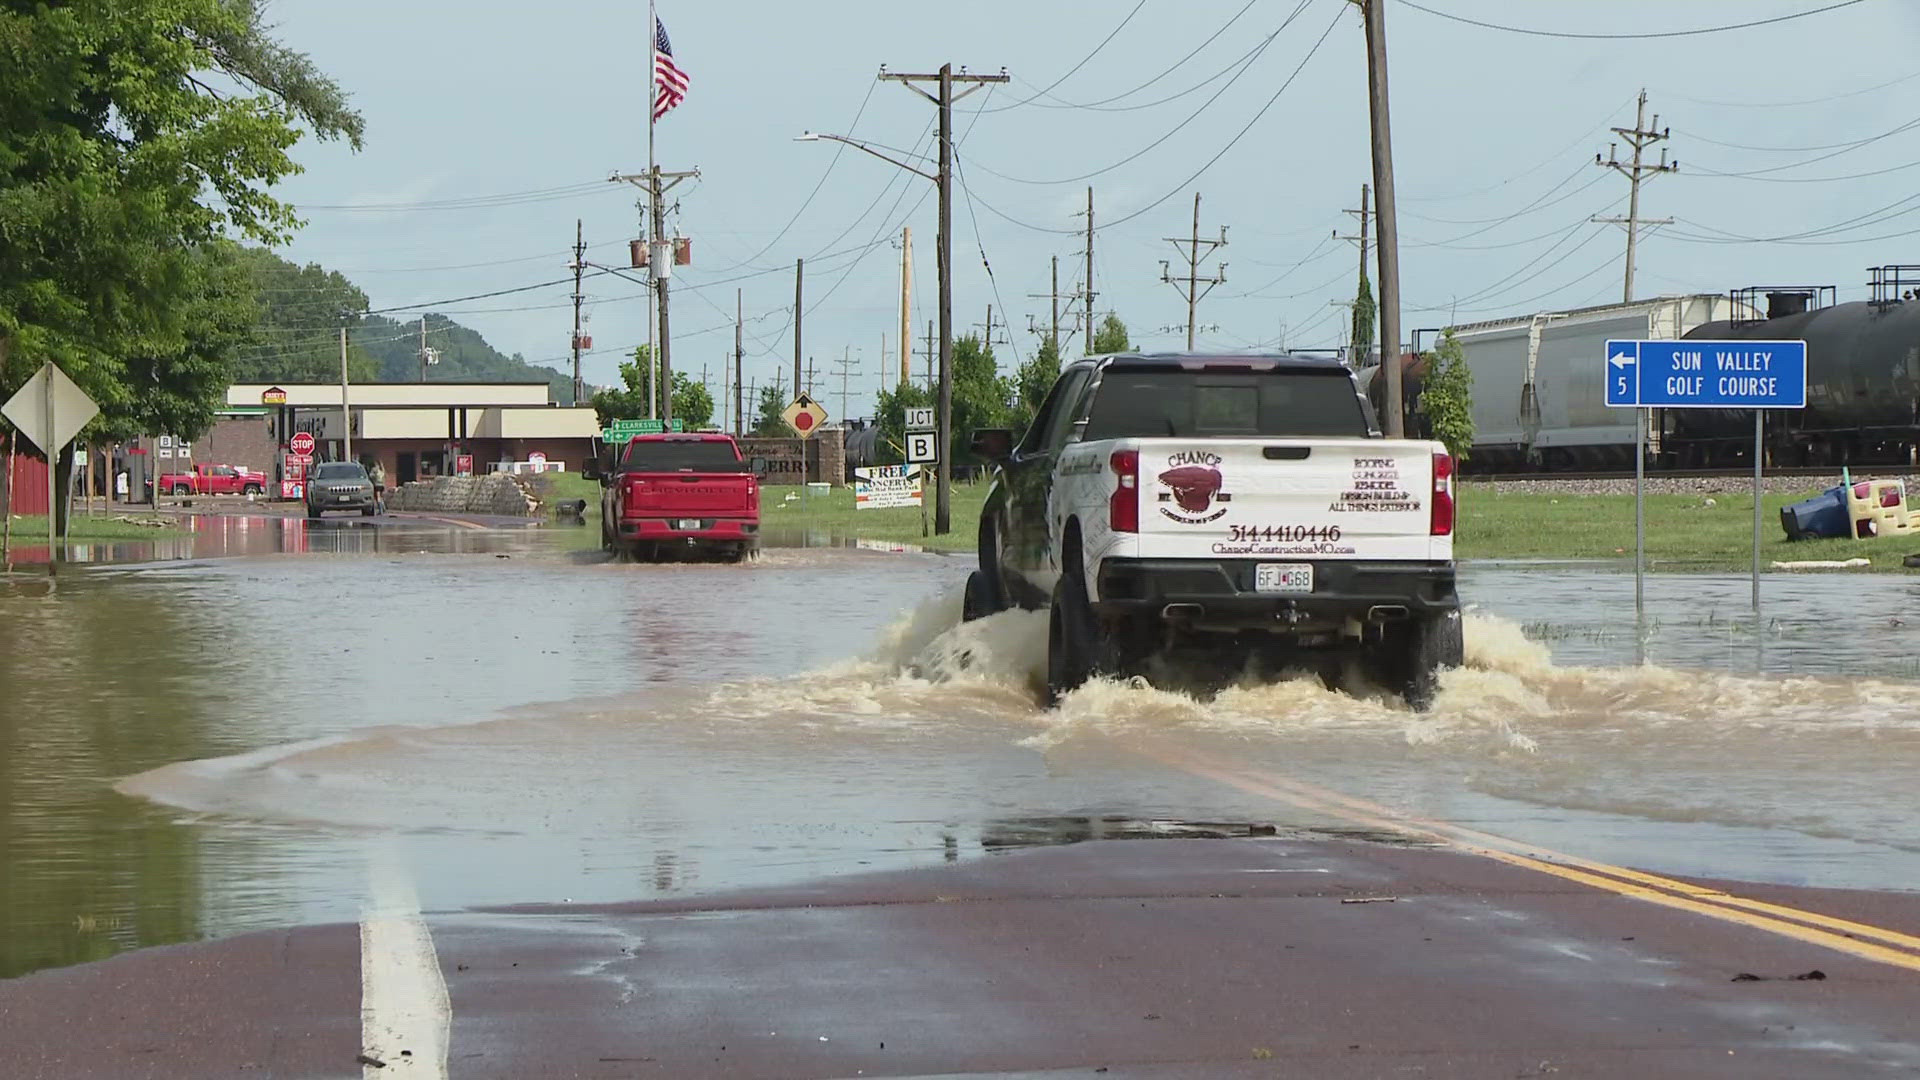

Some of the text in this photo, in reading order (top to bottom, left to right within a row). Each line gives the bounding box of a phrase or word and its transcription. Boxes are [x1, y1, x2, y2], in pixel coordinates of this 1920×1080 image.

[1671, 352, 1772, 370] SUN VALLEY
[1617, 376, 1627, 395] 5
[1666, 377, 1777, 396] GOLF COURSE
[908, 410, 932, 425] JCT
[621, 421, 663, 429] CLARKSVILL
[293, 440, 313, 449] STOP
[915, 439, 928, 456] B
[1354, 458, 1394, 468] ROOFING
[869, 466, 908, 478] FREE
[1354, 481, 1397, 490] REMODEL
[1328, 502, 1421, 512] ALL THINGS EXTERIOR
[1212, 543, 1356, 554] ChanceConstructionMO.com
